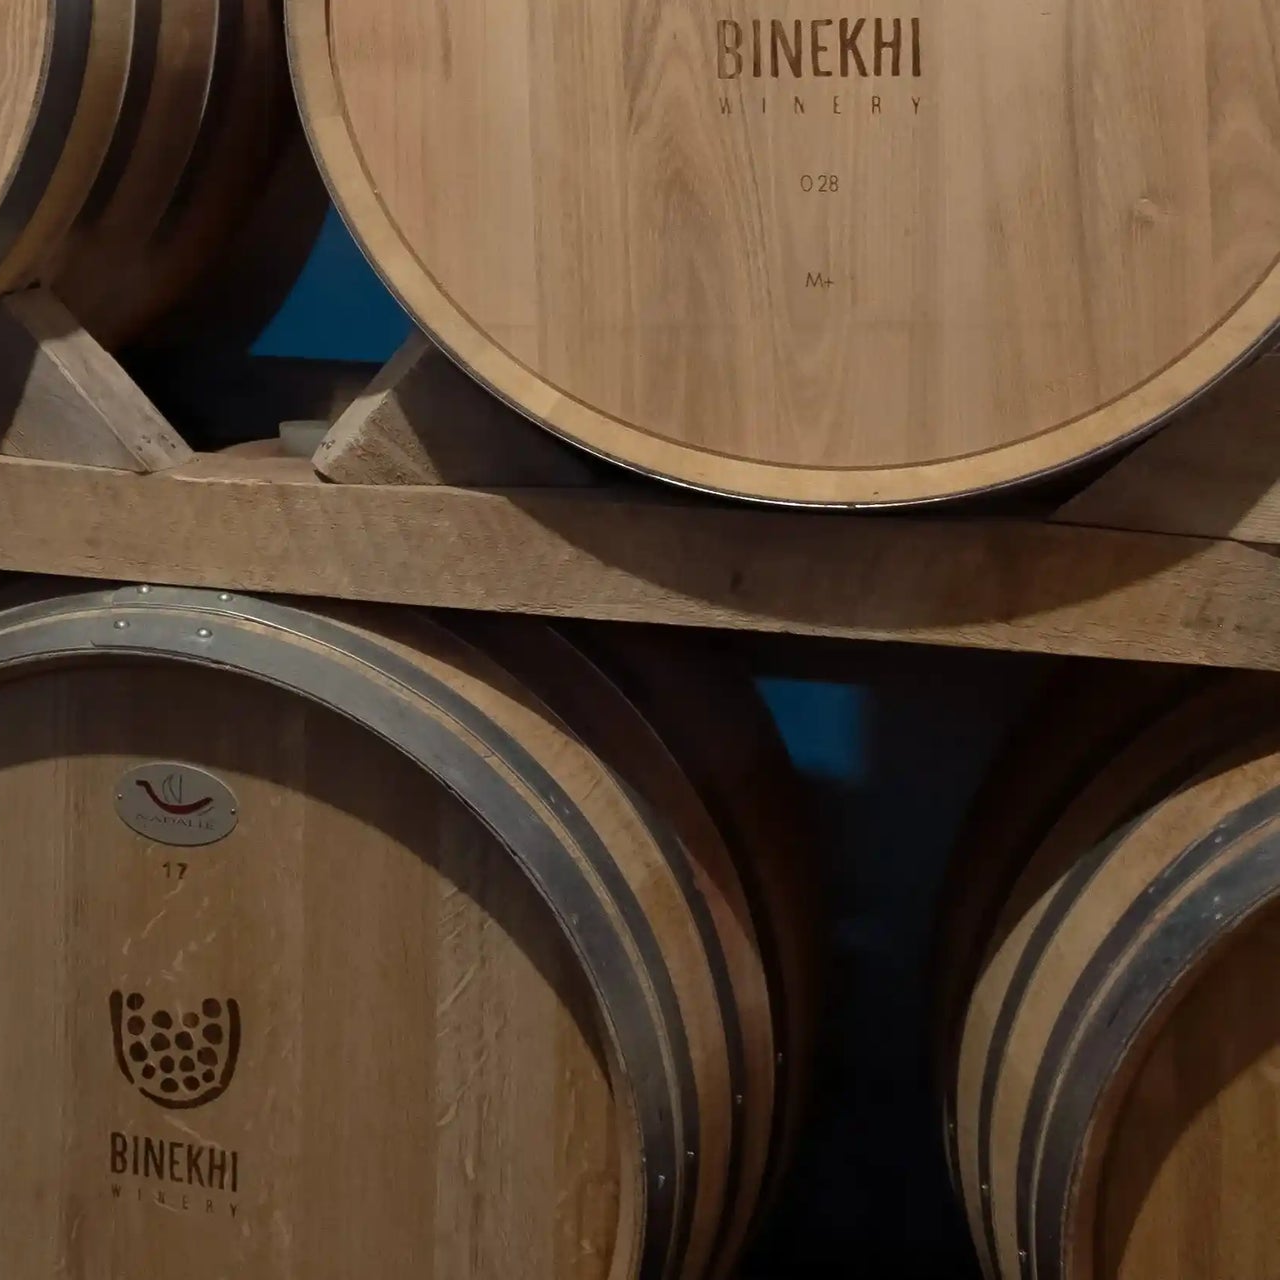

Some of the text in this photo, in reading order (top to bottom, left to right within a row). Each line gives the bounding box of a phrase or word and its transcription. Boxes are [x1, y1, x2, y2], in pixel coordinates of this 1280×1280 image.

[716, 17, 922, 80] BINEKHI
[718, 95, 921, 115] WINERY
[805, 272, 835, 289] M+
[162, 861, 188, 880] 17
[110, 1131, 239, 1193] BINEKHI
[111, 1183, 238, 1219] WINERY
